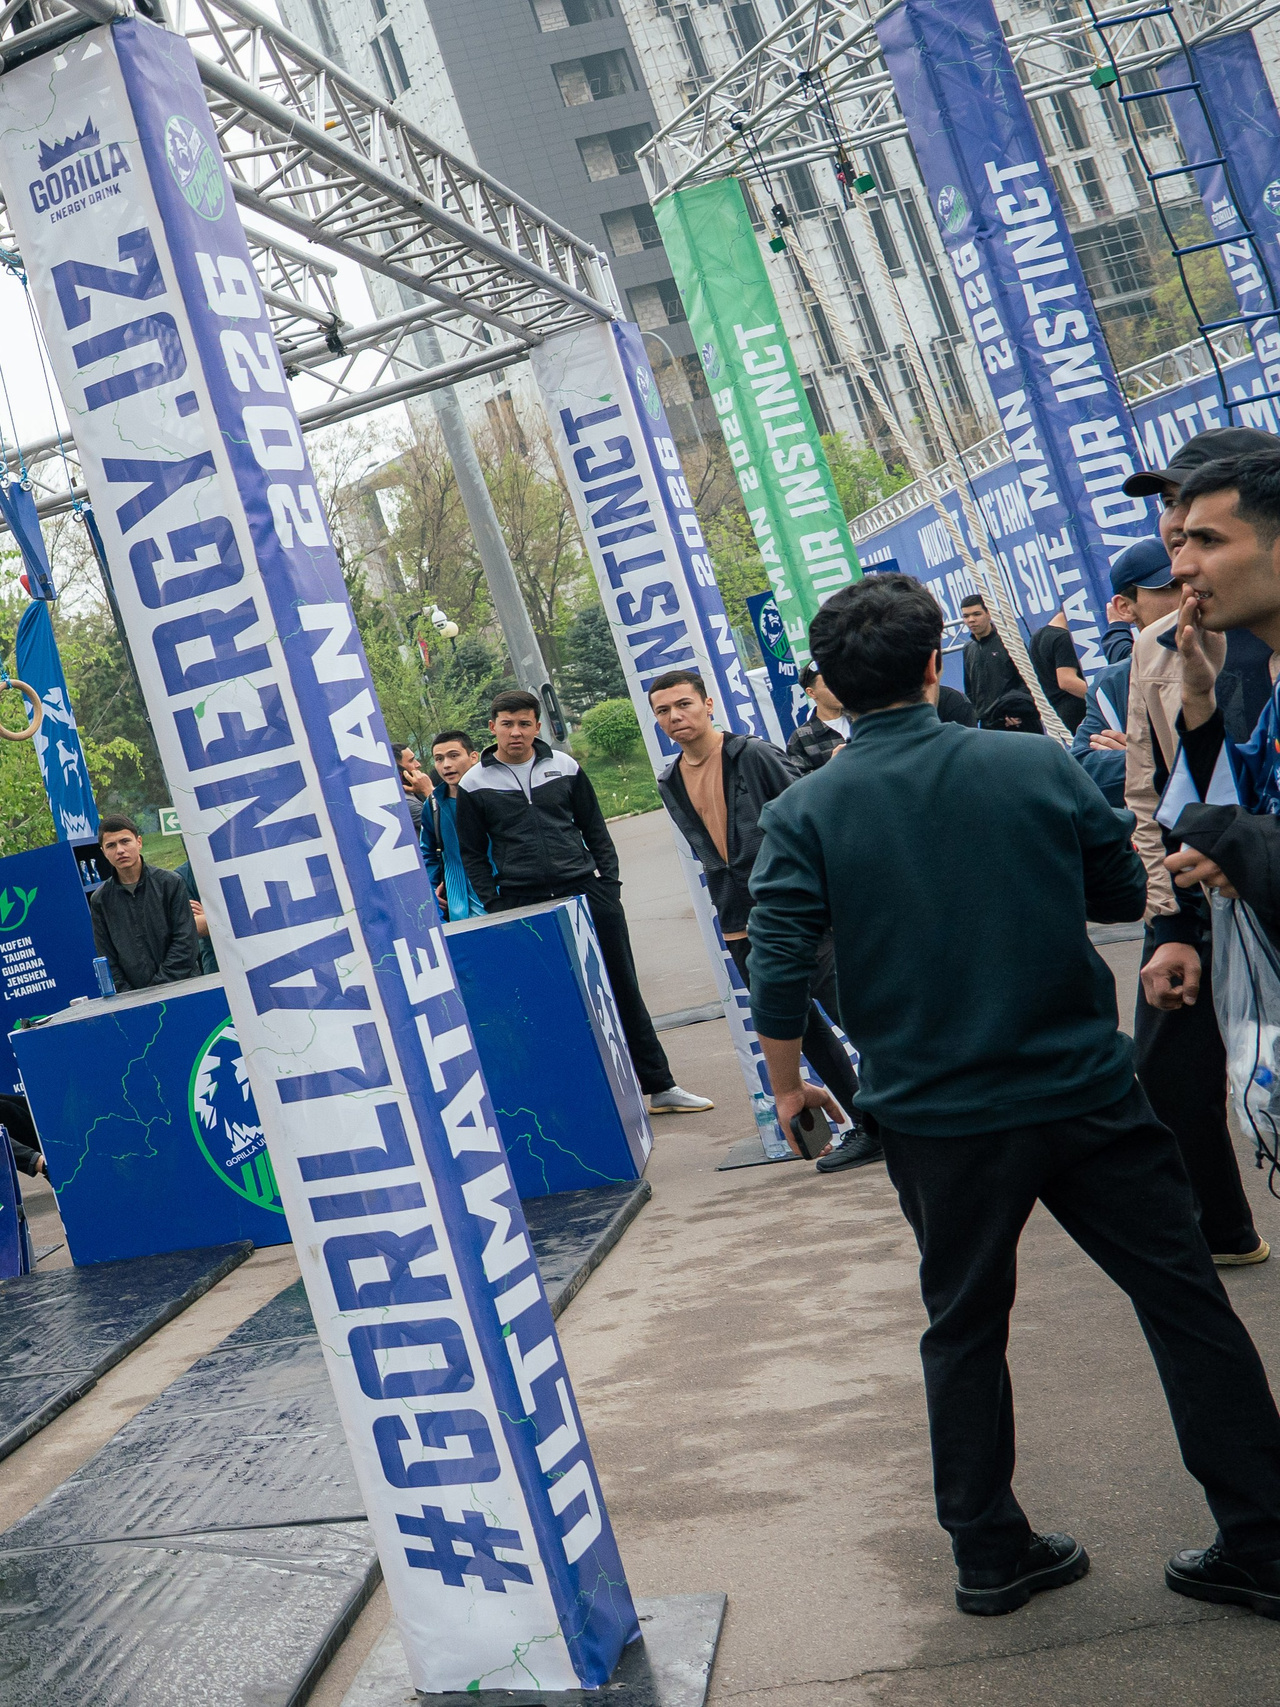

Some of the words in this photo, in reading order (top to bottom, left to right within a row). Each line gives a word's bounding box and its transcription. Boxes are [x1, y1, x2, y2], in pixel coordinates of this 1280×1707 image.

[29, 142, 131, 214] GORILLA
[50, 198, 87, 224] ENERGY
[88, 183, 122, 206] DRINK
[951, 241, 1014, 375] 2026
[984, 160, 1108, 402] INSTINCT
[194, 254, 329, 549] 2026
[712, 387, 760, 494] 2026
[733, 323, 830, 518] INSTINCT
[998, 389, 1059, 511] MAN
[655, 437, 718, 587] 2026
[748, 506, 793, 604] MAN
[1040, 527, 1108, 687] MATE
[708, 614, 763, 739] MAN
[297, 602, 421, 881] MAN
[0, 936, 33, 953] KOFEIN
[1, 957, 45, 977] GUARANA
[3, 948, 36, 964] TAURIN
[51, 226, 536, 1595] #GORILLAENERGY.UZ
[4, 978, 57, 1001] L-KARNITIN
[7, 969, 47, 988] JENSHEN
[225, 1145, 259, 1167] GORILLA
[393, 926, 603, 1564] ULTIMATE
